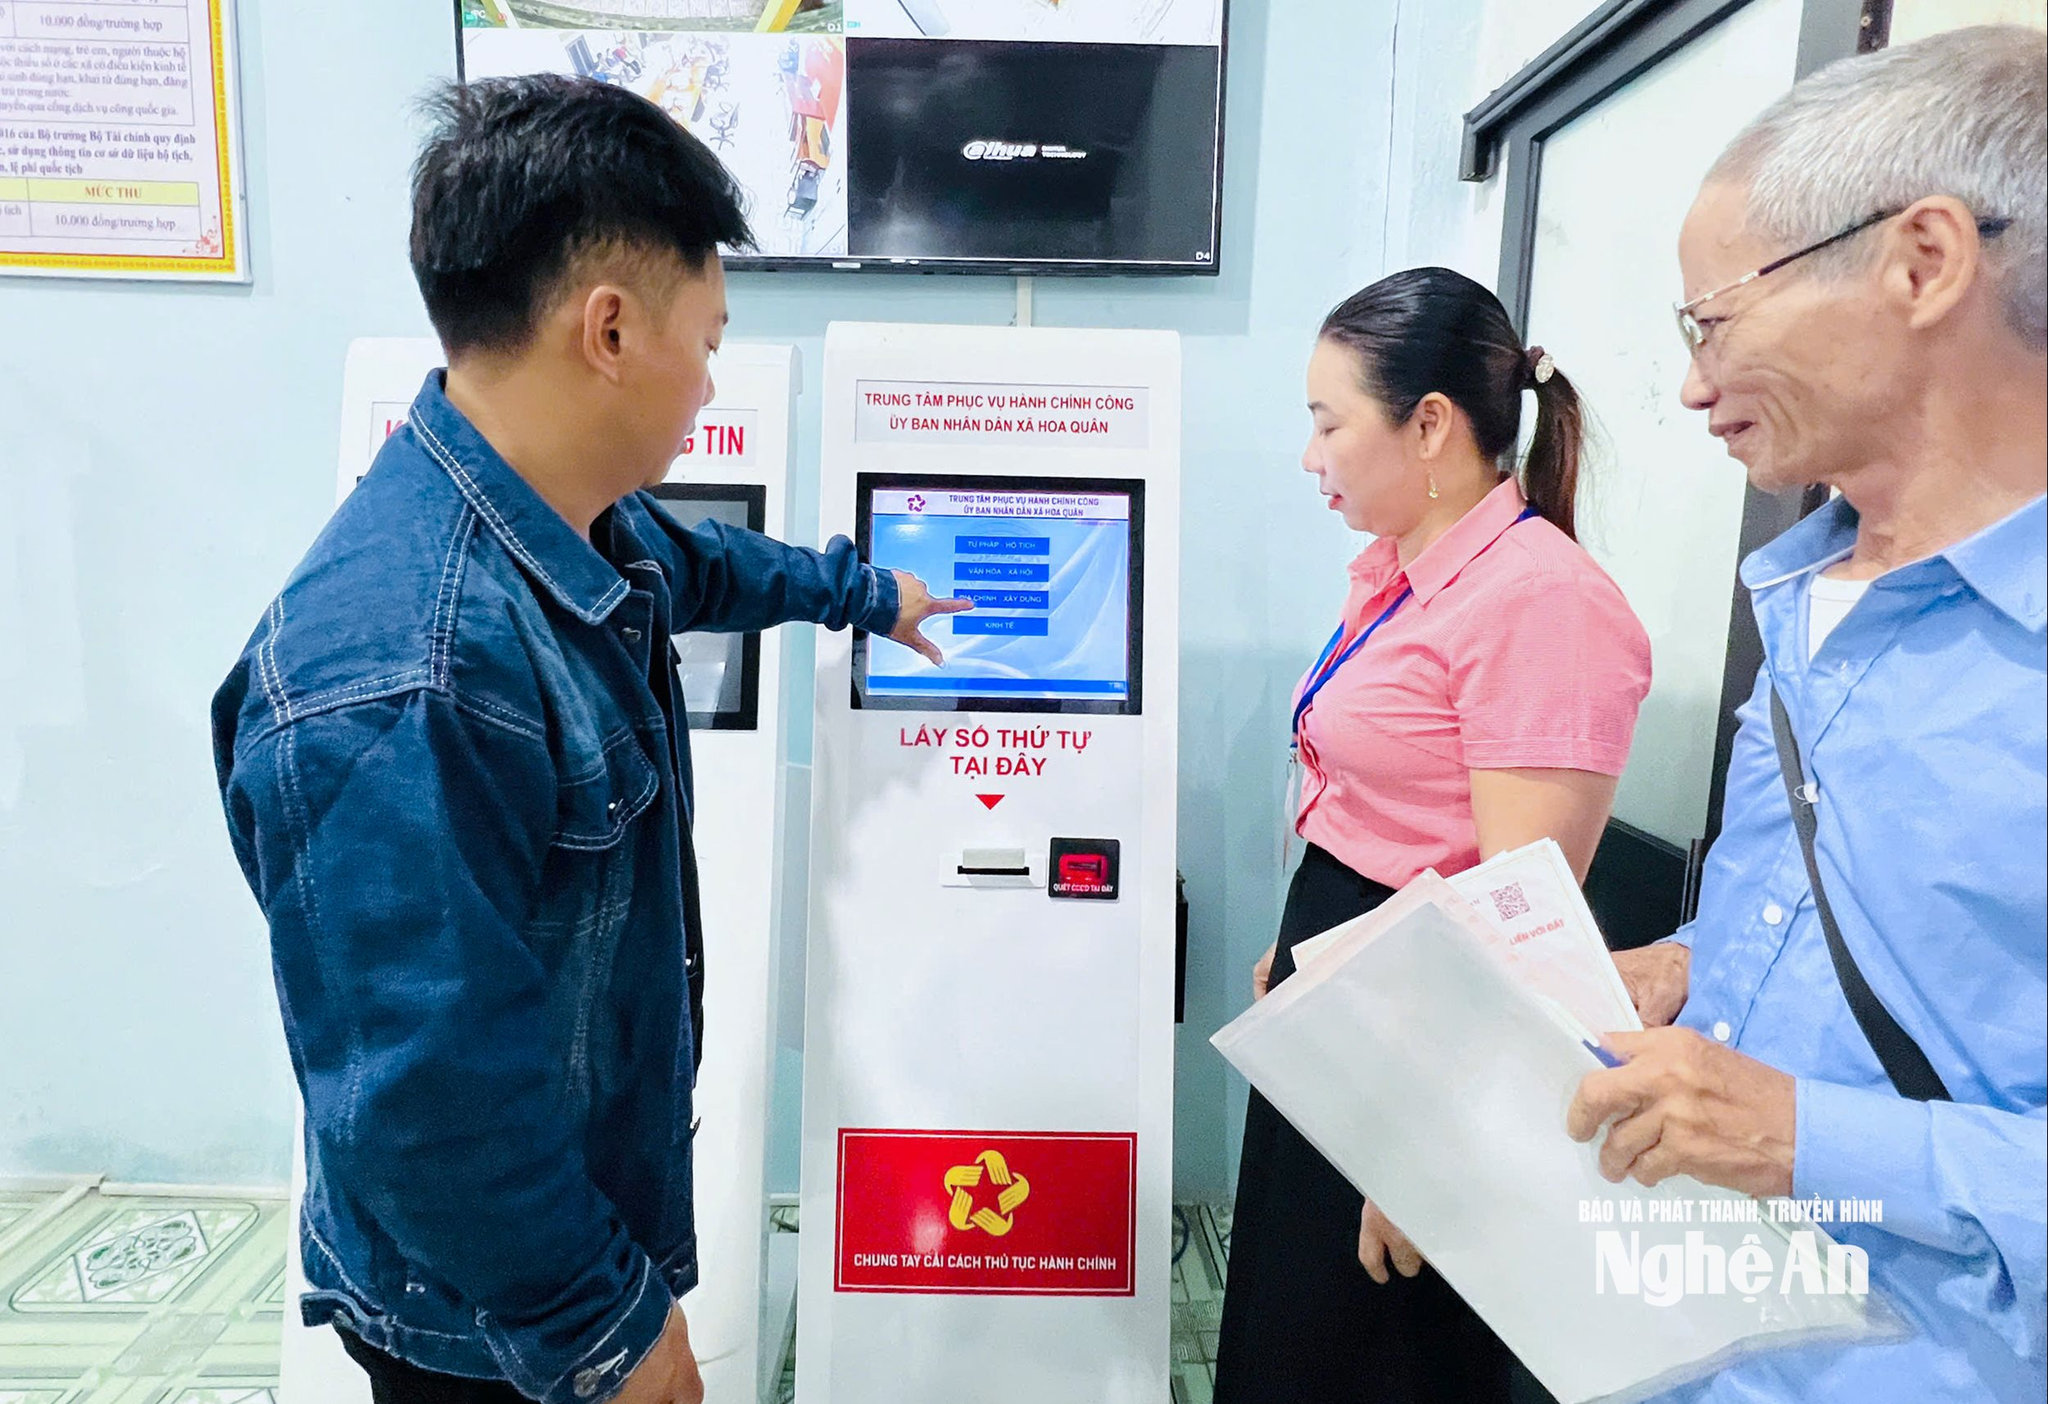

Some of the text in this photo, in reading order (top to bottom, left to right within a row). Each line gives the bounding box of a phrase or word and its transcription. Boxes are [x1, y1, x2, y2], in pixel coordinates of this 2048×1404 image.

[84, 185, 142, 199] MỨC THU
[1196, 251, 1210, 260] D4
[865, 391, 1134, 411] TRUNG TÂM PHỤC VỤ HÀNH CHÍNH CÔNG
[890, 414, 1108, 434] ỦY BAN NHÂN DÂN XÃ HOA QUÂN
[703, 425, 744, 455] TIN
[949, 494, 1099, 506] TRUNG TÂM PHỤC VỤ HÀNH CHÍNH CÔNG
[975, 506, 991, 514] BAN
[993, 506, 1014, 515] NHÂN
[1016, 506, 1032, 516] DÂN
[1033, 507, 1043, 516] XÃ
[1045, 508, 1061, 516] HOA
[1062, 507, 1083, 518] QUÂN
[900, 723, 1092, 754] LẤY SỐ THỨ TỰ
[950, 753, 1047, 780] TẠI ĐÂY
[854, 1251, 1116, 1273] CHUNG TAY CẢI CÁCH THỦ TỤC HÀNH CHÍNH
